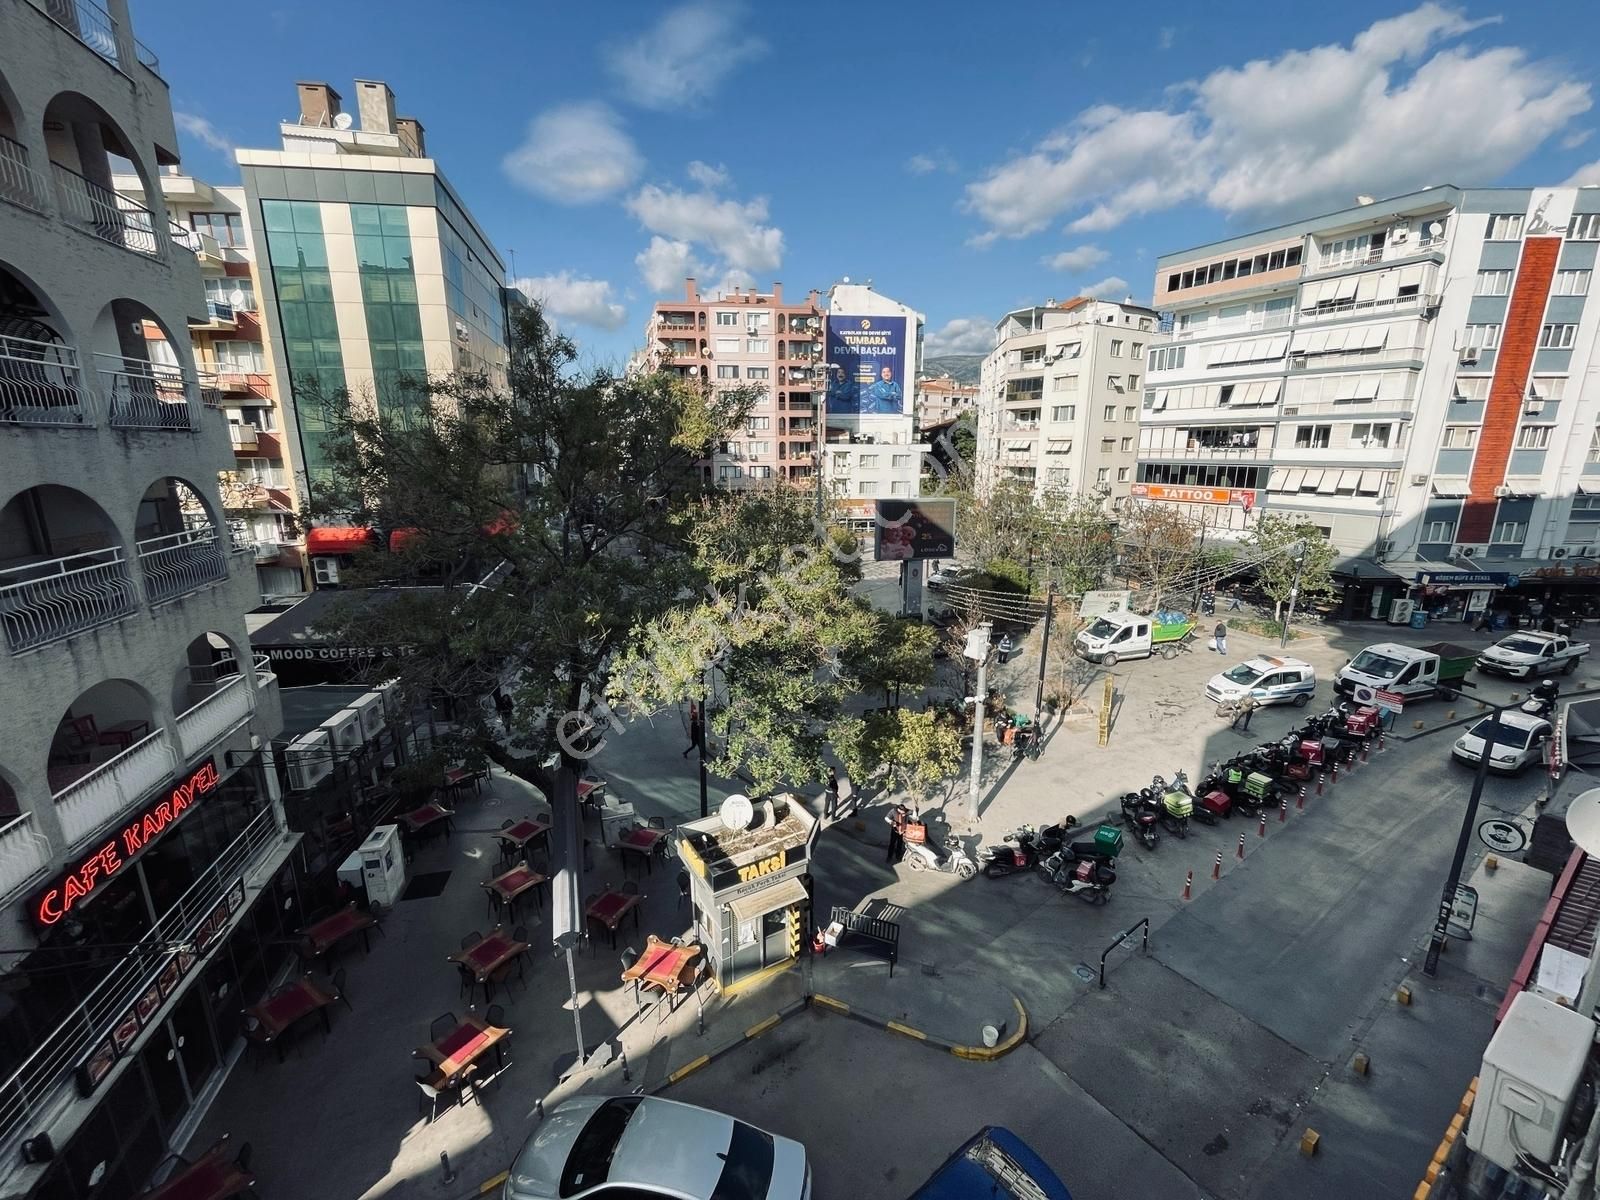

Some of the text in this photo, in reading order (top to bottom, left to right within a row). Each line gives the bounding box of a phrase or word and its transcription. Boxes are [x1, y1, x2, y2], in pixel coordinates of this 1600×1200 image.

[844, 336, 887, 345] TUMBARA
[834, 344, 897, 357] DEVRİ BAŞLADI
[1162, 488, 1213, 500] TATTOO
[270, 649, 314, 660] MOOD
[319, 647, 376, 659] COFFEE
[39, 762, 221, 924] CAFE KARAYEL
